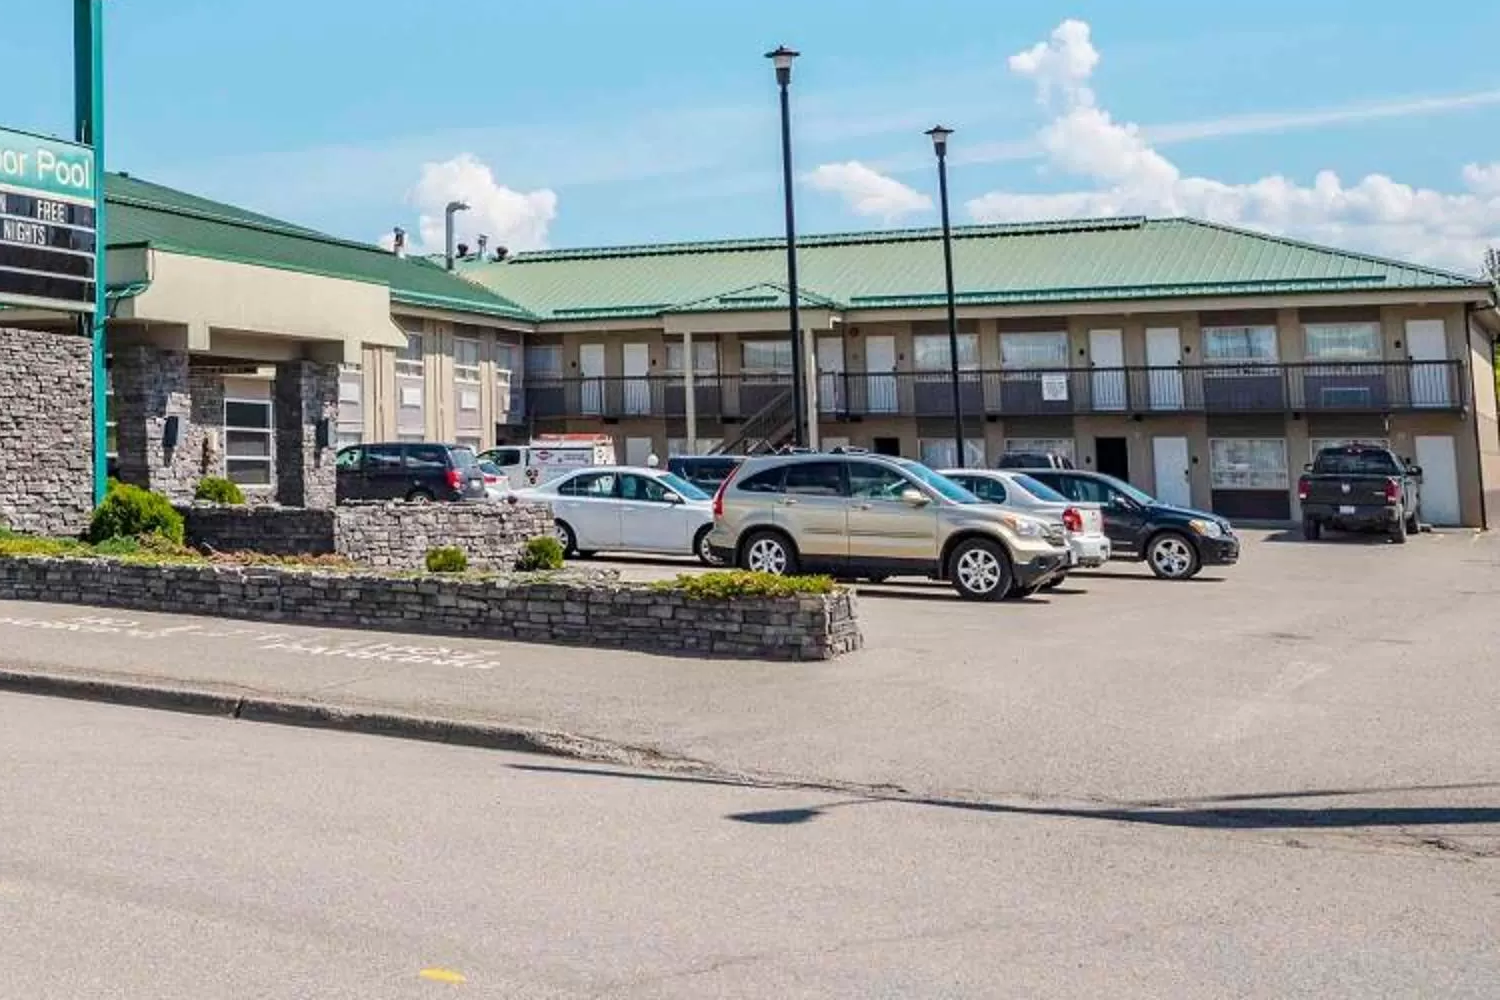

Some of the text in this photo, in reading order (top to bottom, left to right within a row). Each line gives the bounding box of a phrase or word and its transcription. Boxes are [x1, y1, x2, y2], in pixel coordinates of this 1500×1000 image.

[37, 150, 90, 189] Pool
[37, 198, 66, 224] FREE
[4, 220, 46, 245] NIGHTS
